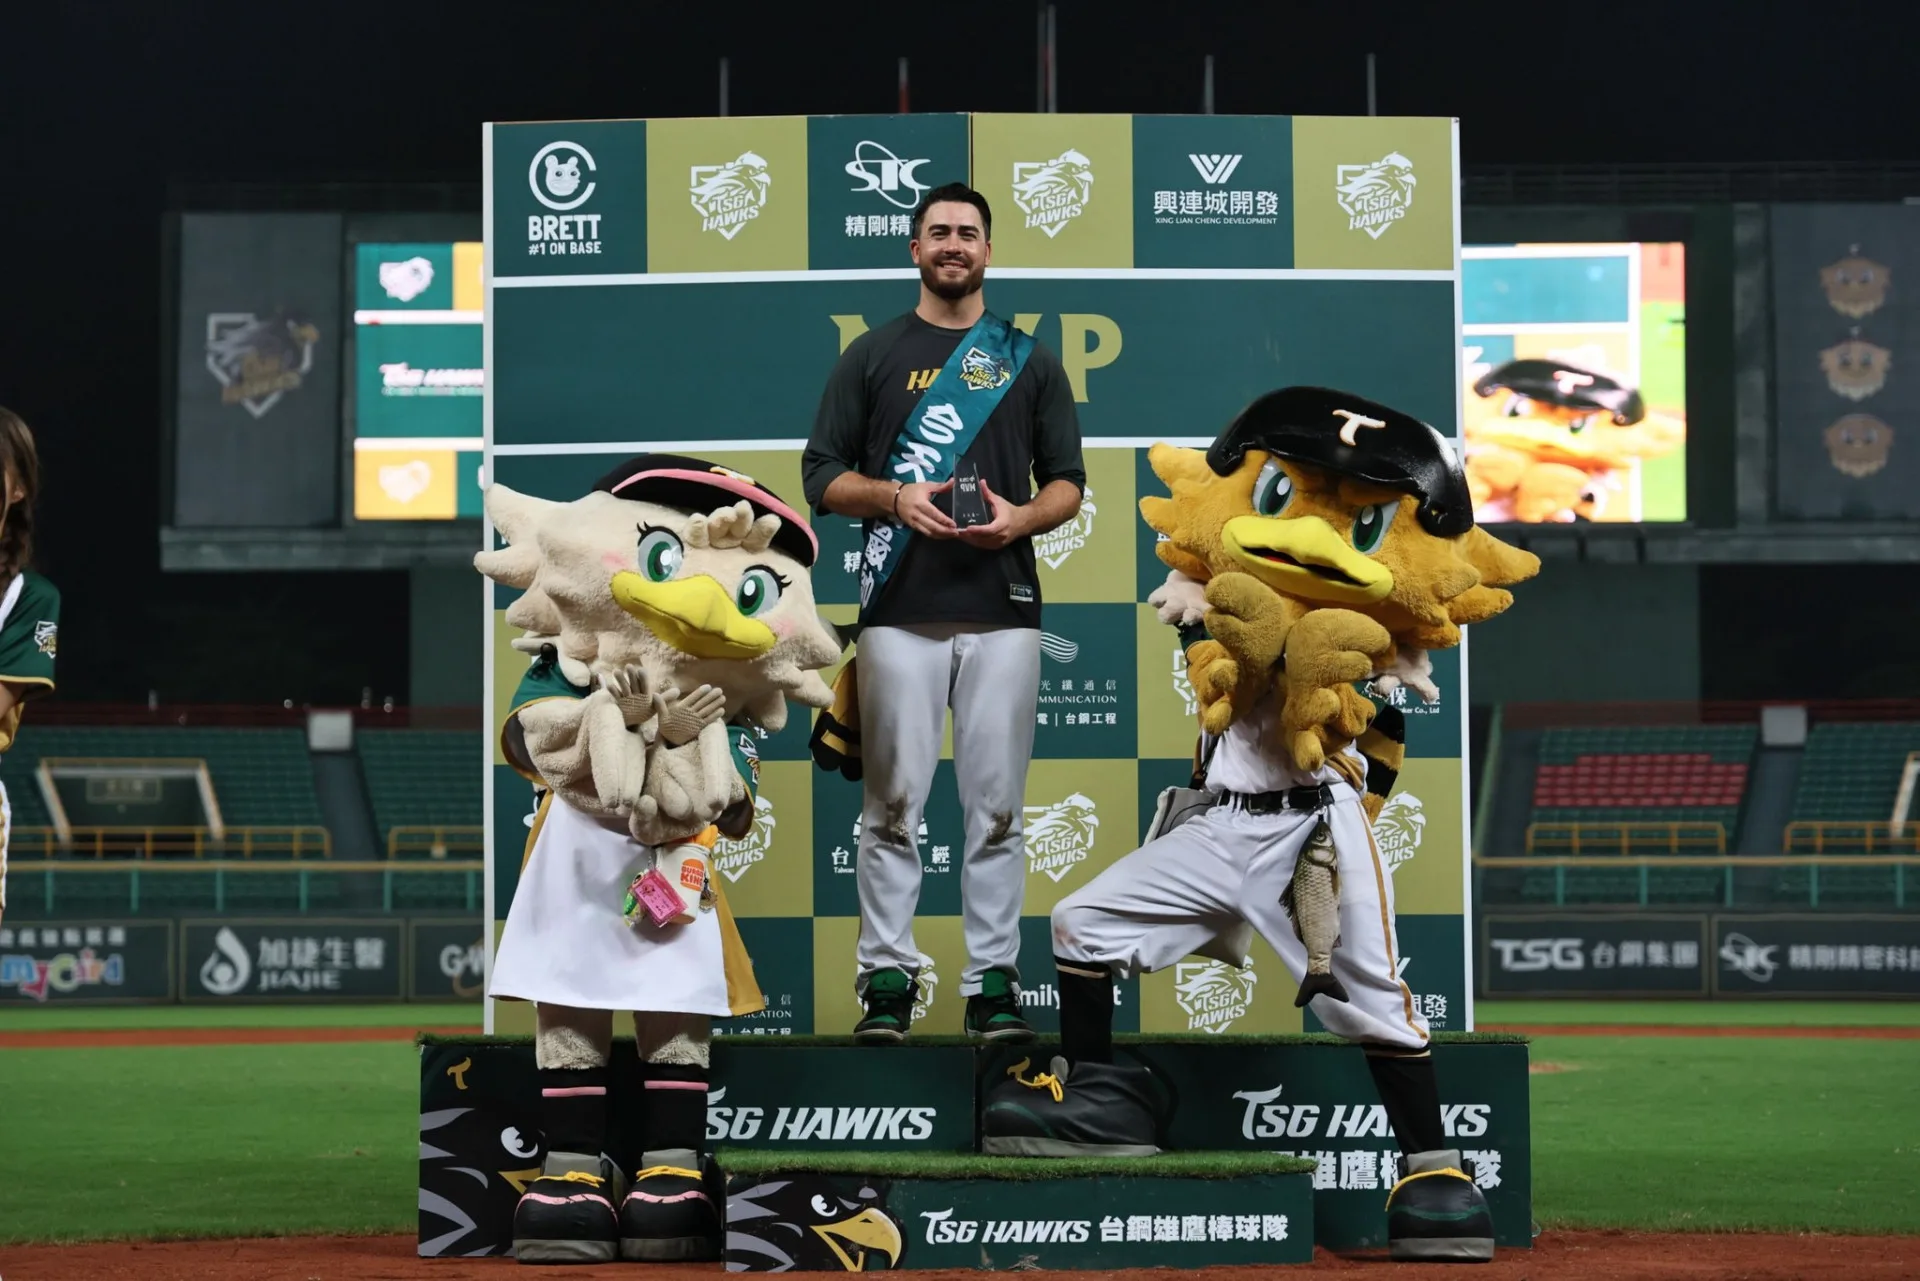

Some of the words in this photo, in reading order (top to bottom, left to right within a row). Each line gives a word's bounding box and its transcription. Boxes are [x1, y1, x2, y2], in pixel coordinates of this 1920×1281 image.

[1153, 190, 1279, 215] 興連城開發
[528, 214, 602, 241] BRETT
[702, 205, 759, 232] HAWKS
[845, 214, 911, 237] 精剛精
[1025, 203, 1082, 228] HAWKS
[1223, 217, 1277, 225] DEVELOPMENT
[1349, 205, 1405, 230] HAWKS
[528, 242, 546, 255] #1
[549, 242, 566, 255] ON
[570, 241, 602, 254] BASE
[1041, 680, 1117, 691] 光纖通信
[1038, 695, 1117, 703] MMUNICATION
[1030, 847, 1087, 873] HAWKS
[1490, 938, 1584, 971] TSG
[1188, 1004, 1246, 1030] HAWKS
[768, 1106, 937, 1141] HAWKS
[1232, 1083, 1320, 1140] TSG
[1325, 1104, 1491, 1138] HAKS
[920, 1207, 978, 1245] TSG
[981, 1220, 1091, 1243] HAWKS
[1099, 1215, 1289, 1242] 台鋼雄鷹棒球隊
